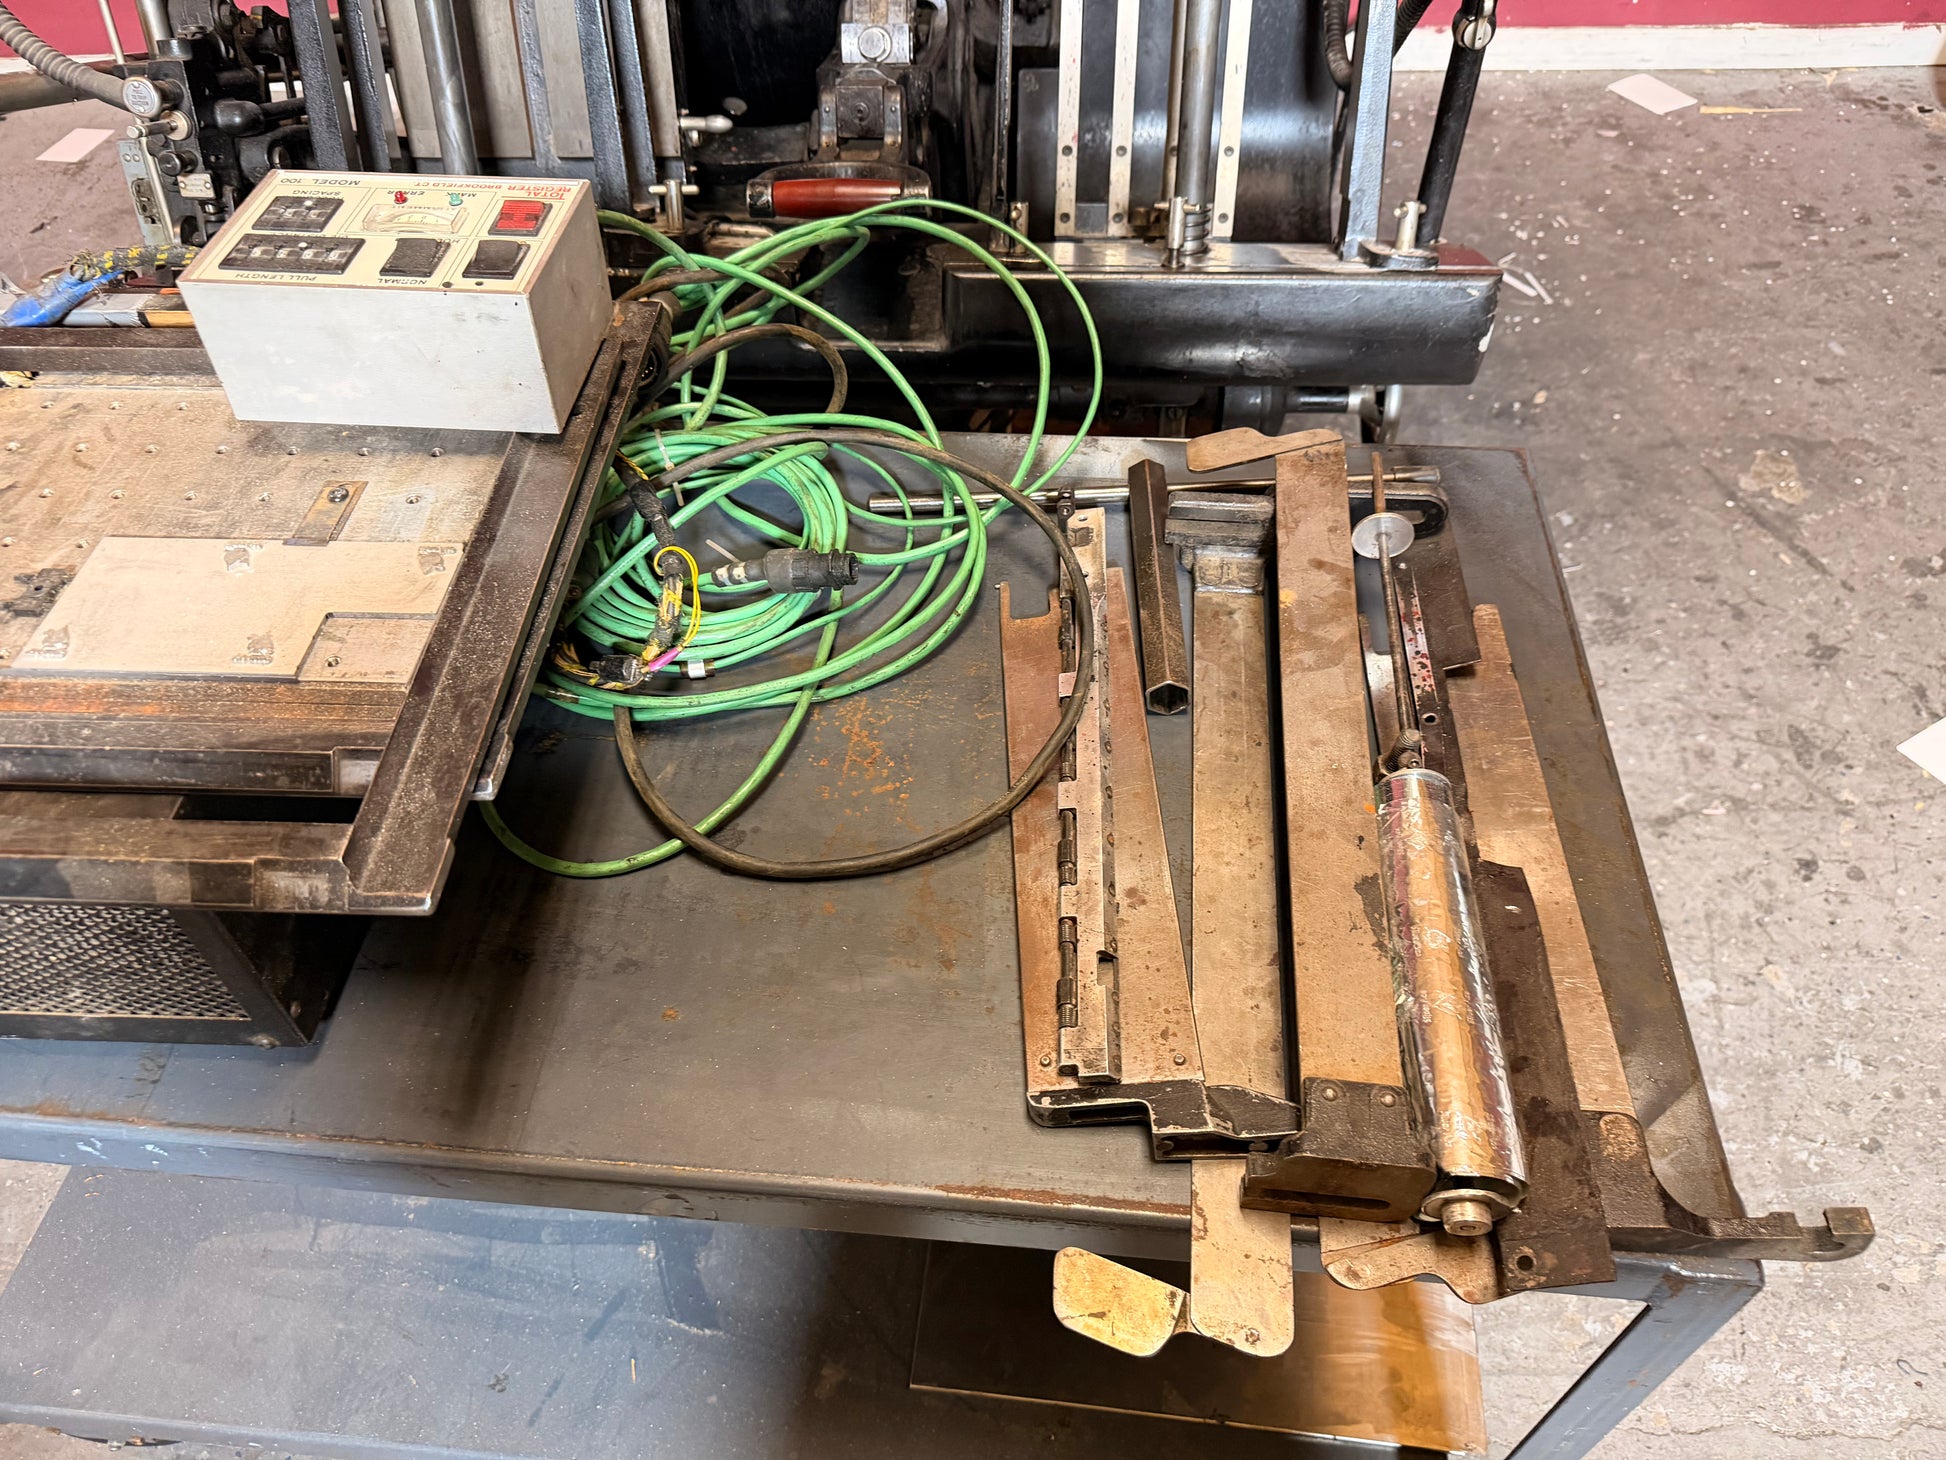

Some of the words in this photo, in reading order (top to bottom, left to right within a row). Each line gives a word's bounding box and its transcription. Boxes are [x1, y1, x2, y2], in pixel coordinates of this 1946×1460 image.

[312, 178, 361, 186] MODEL
[507, 185, 572, 193] REGISTER
[527, 191, 565, 199] TOTAL
